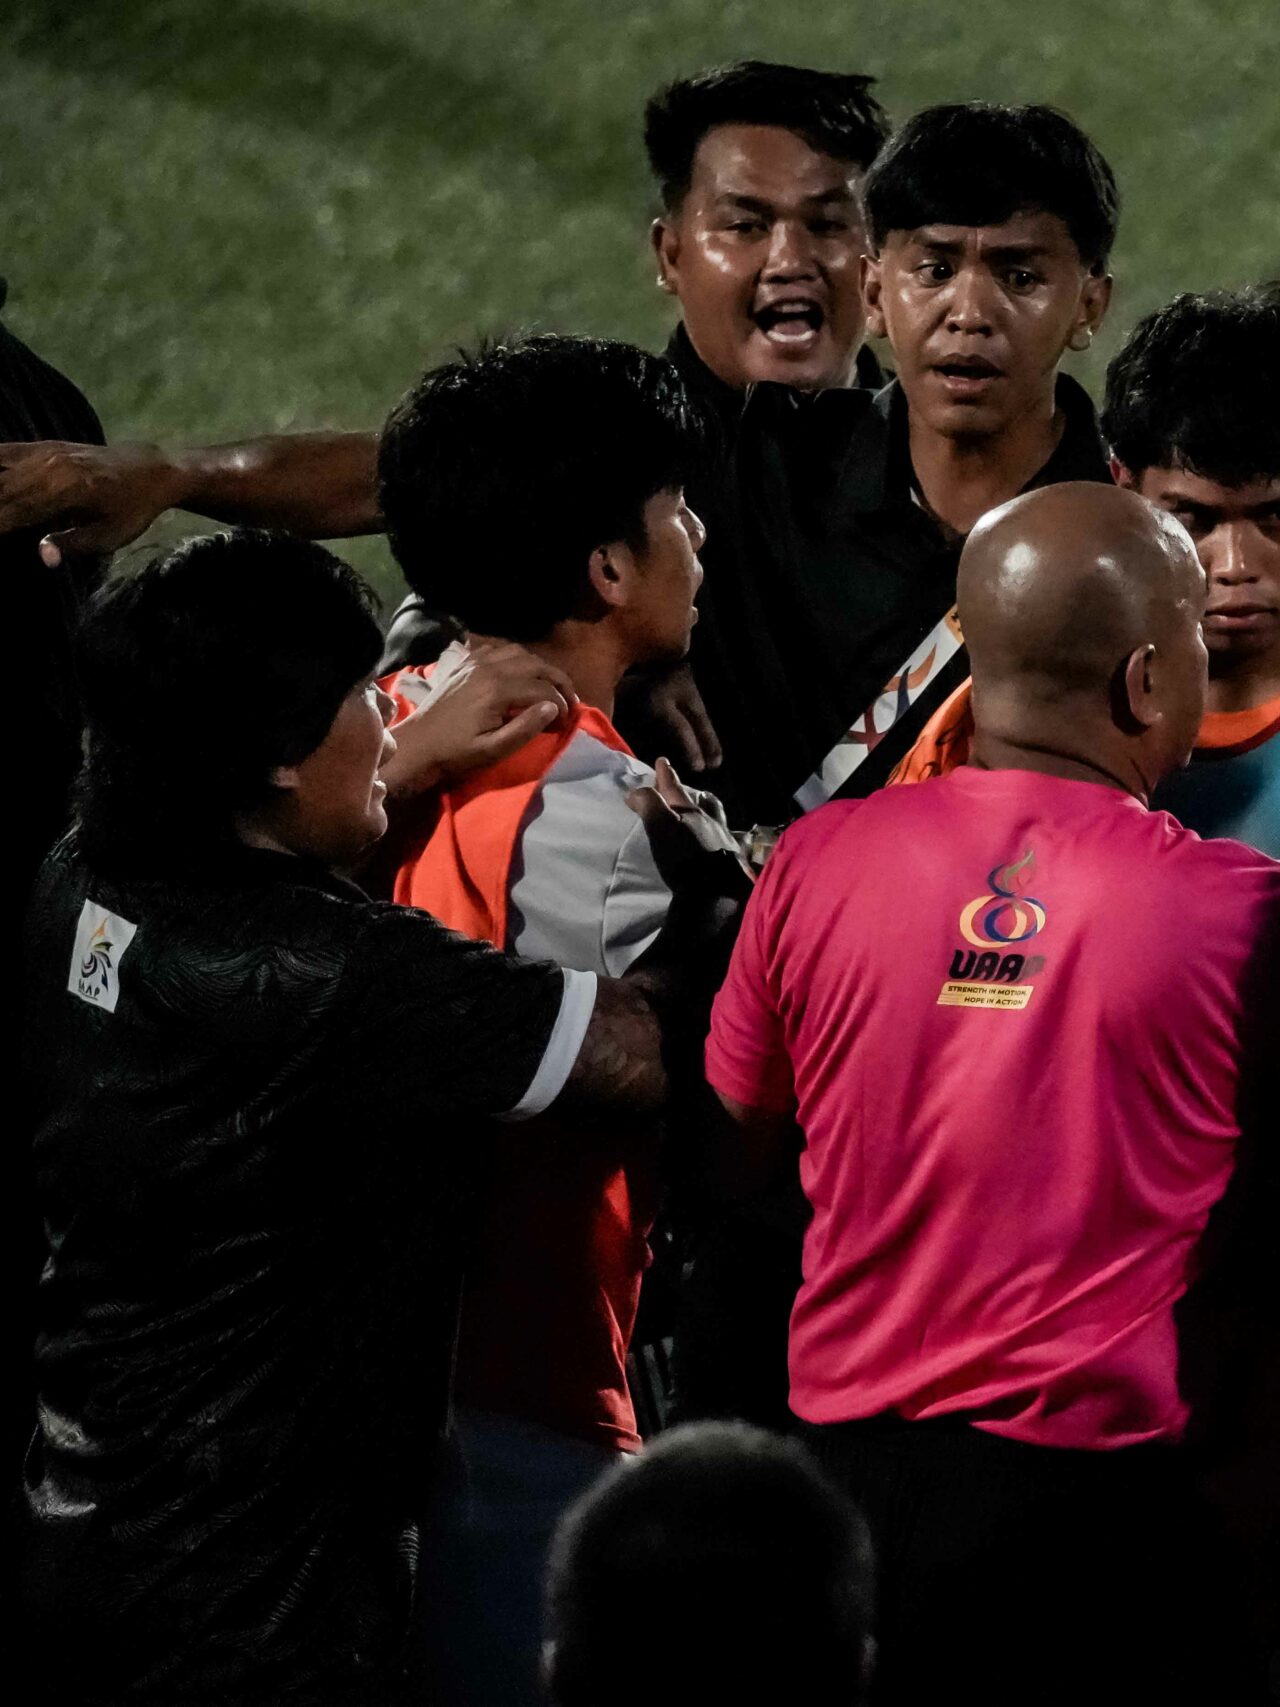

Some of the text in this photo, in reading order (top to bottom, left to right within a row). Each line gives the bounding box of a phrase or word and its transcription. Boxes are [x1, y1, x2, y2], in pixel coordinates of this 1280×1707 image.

[947, 985, 987, 995] STRENGTH
[997, 989, 1027, 997] MOTION
[964, 996, 986, 1004] HOPE
